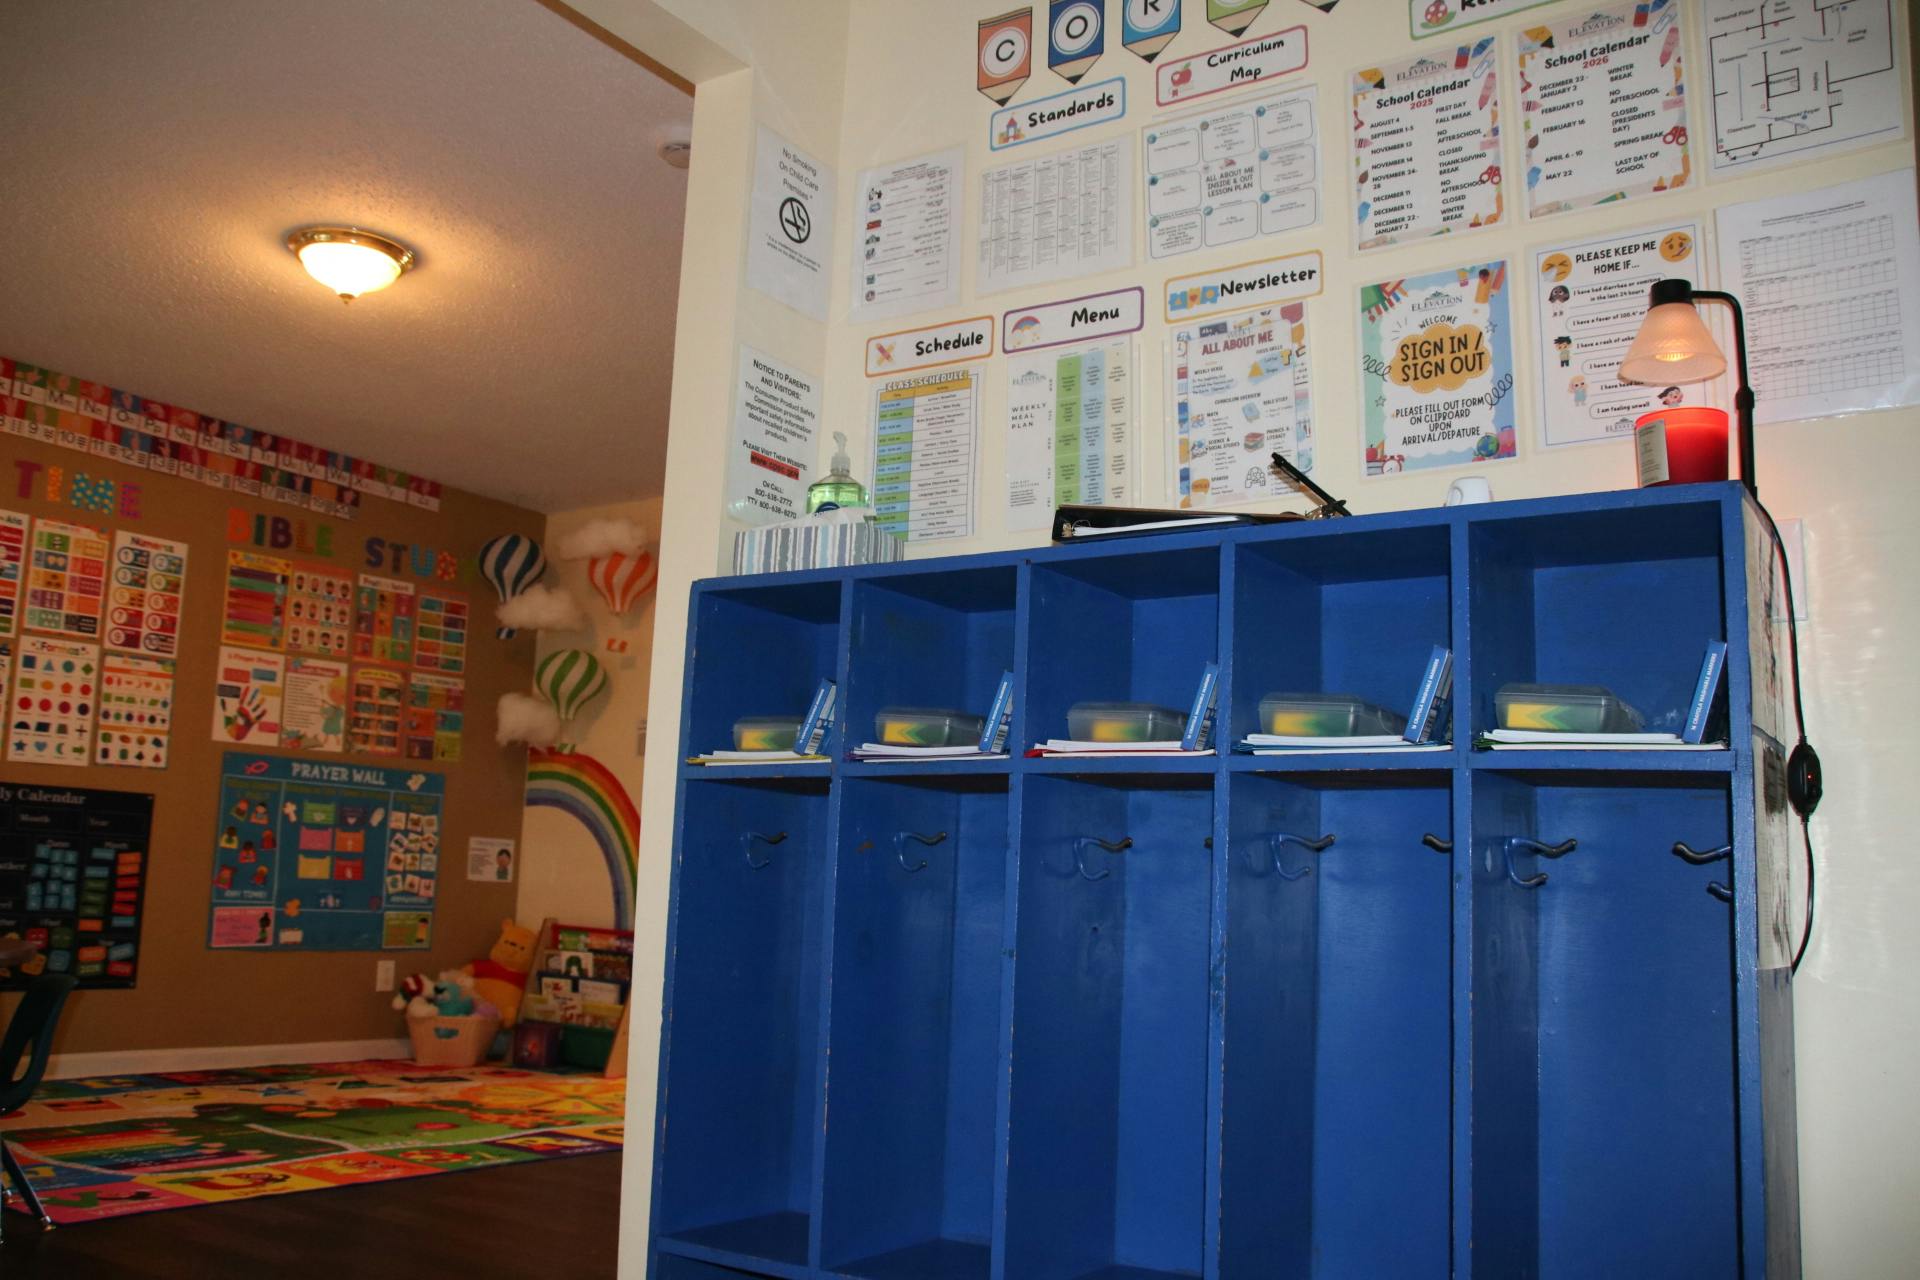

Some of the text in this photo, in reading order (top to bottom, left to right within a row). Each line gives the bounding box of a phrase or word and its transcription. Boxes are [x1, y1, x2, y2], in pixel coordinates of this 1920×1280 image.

[1568, 15, 1625, 38] ELEVATION
[1207, 40, 1285, 67] Curriculum
[1544, 35, 1650, 69] School Calendar
[1583, 56, 1609, 69] 2026
[1608, 63, 1634, 76] WINTER
[1230, 66, 1262, 82] Map
[1397, 61, 1448, 81] ELEVATION
[1609, 71, 1633, 82] BREAK
[1539, 78, 1573, 91] DECEMBER
[1376, 79, 1470, 109] School Calendar
[1540, 87, 1571, 99] JANUARY
[1609, 89, 1621, 97] NO
[1610, 87, 1660, 105] AFTERSCHOOL
[1028, 92, 1114, 128] Standards
[1410, 98, 1433, 110] 2025
[1435, 101, 1467, 114] FIRST DAY
[1541, 102, 1574, 115] FEBRUARY
[1435, 110, 1473, 125] FALL BREAK
[1611, 106, 1639, 118] CLOSED
[1370, 118, 1394, 129] AUGUST
[1543, 121, 1576, 134] FEBRUARY
[1371, 128, 1403, 140] SEPTEMBER
[1437, 129, 1448, 137] NO
[1437, 128, 1483, 144] AFTERSCHOOL
[1614, 131, 1664, 148] SPRING BREAK
[1371, 143, 1403, 155] NOVEMBER
[1438, 146, 1463, 157] CLOSED
[782, 148, 817, 177] No Smoking
[1371, 159, 1404, 170] NOVEMBER
[1439, 152, 1487, 168] THANKSGIVING
[1545, 154, 1564, 164] APRIL
[1615, 157, 1632, 167] LAST
[1633, 153, 1649, 163] DAY
[1206, 166, 1255, 183] ALL ABOUT ME
[1439, 166, 1460, 176] BREAK
[1616, 163, 1645, 174] SCHOOL
[779, 161, 819, 192] On Child Care
[1207, 180, 1231, 190] INSIDE
[1240, 174, 1254, 183] OUT
[1372, 171, 1405, 183] NOVEMBER
[1546, 172, 1562, 181] MAY
[1208, 182, 1254, 198] LESSON PLAN
[1373, 192, 1404, 203] DECEMBER
[1442, 194, 1466, 205] CLOSED
[1374, 205, 1404, 216] DECEMBER
[1441, 205, 1465, 215] WINTER
[1374, 217, 1405, 229] DECEMBER
[1442, 213, 1463, 223] BREAK
[1375, 225, 1402, 236] JANUARY
[1575, 240, 1657, 264] PLEASE KEEP ME
[1593, 263, 1621, 275] HOME
[1220, 268, 1317, 297] Newsletter
[1411, 295, 1463, 312] ELEVATION
[1070, 307, 1121, 328] Menu
[1418, 315, 1458, 329] WELCOME
[915, 331, 984, 356] Schedule
[1201, 330, 1274, 356] ALL ABOUT ME
[1400, 331, 1483, 362] SIGN IN /
[1401, 351, 1485, 383] SIGN OUT
[753, 359, 775, 376] NOTICE
[784, 373, 811, 393] PARENTS
[745, 381, 816, 420] The Consumer Product Safety
[1011, 402, 1047, 413] WEEKLY
[1395, 396, 1485, 418] PLEASE FILL OUT FORM
[754, 394, 805, 423] Commission provides
[745, 401, 812, 435] important safety information
[748, 412, 762, 425] about
[762, 417, 782, 433] recalled
[1011, 413, 1035, 421] MEAL
[1409, 409, 1471, 426] ON CLIPBOARD
[1011, 421, 1034, 430] PLAN
[1428, 421, 1452, 432] UPON
[1401, 426, 1481, 446] ARRIVAL/DEPATURE
[15, 460, 143, 520] TIME
[226, 507, 334, 558] BIBLE
[291, 762, 386, 786] PRAYER WALL
[17, 788, 86, 805] Calendar
